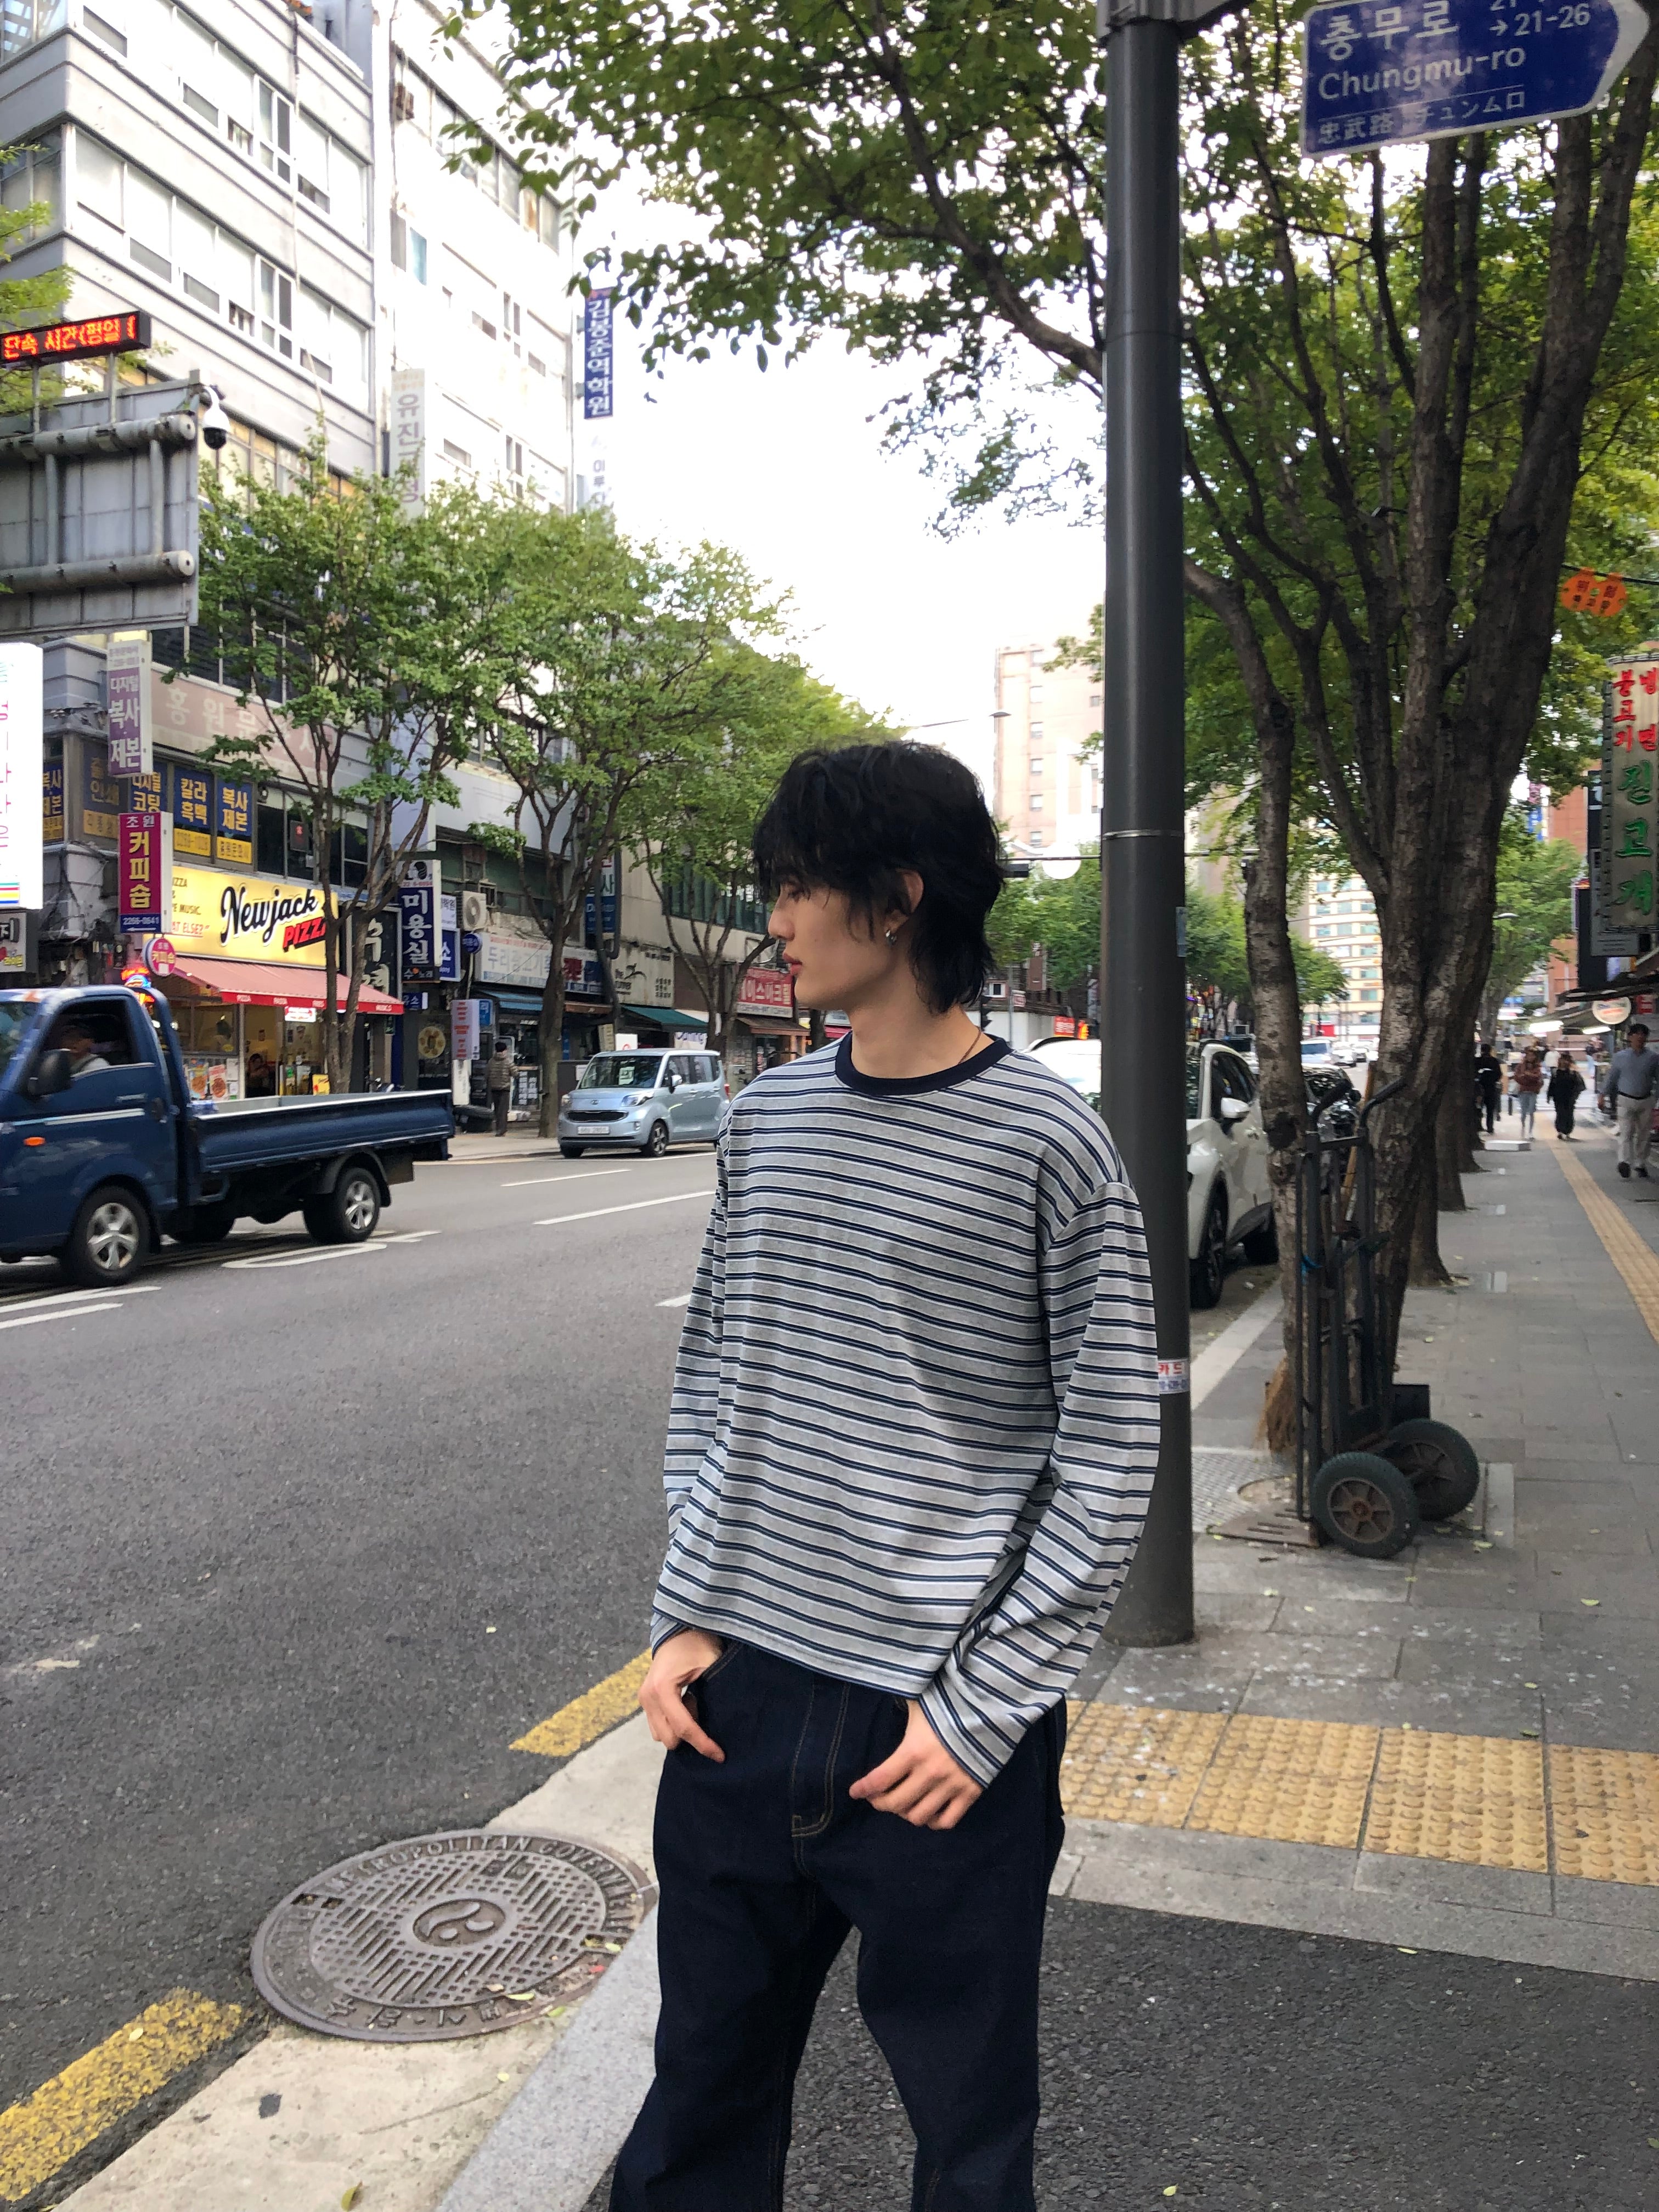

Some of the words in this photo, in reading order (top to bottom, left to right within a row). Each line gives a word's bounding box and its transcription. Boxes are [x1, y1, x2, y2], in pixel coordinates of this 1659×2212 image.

[1320, 0, 1459, 61] 충무로
[1514, 4, 1590, 36] 21-26
[1319, 48, 1526, 101] Chungmu-ro
[1318, 111, 1395, 145] 忠武路
[4, 332, 38, 360] 단속
[397, 393, 420, 503] 유진
[110, 675, 139, 693] 디지털
[110, 698, 140, 729] 복사
[111, 738, 140, 768] 제본
[133, 791, 161, 812] 코팅
[180, 778, 207, 802] 칼라
[223, 787, 248, 811] 복사
[126, 815, 155, 828] 초원
[181, 802, 207, 825] 흑백
[222, 809, 247, 832] 제본
[128, 831, 151, 909] 커피숍
[172, 877, 187, 887] IZZA
[221, 884, 318, 945] Newjack
[401, 889, 432, 964] 미용실
[282, 917, 325, 950] PIZZ
